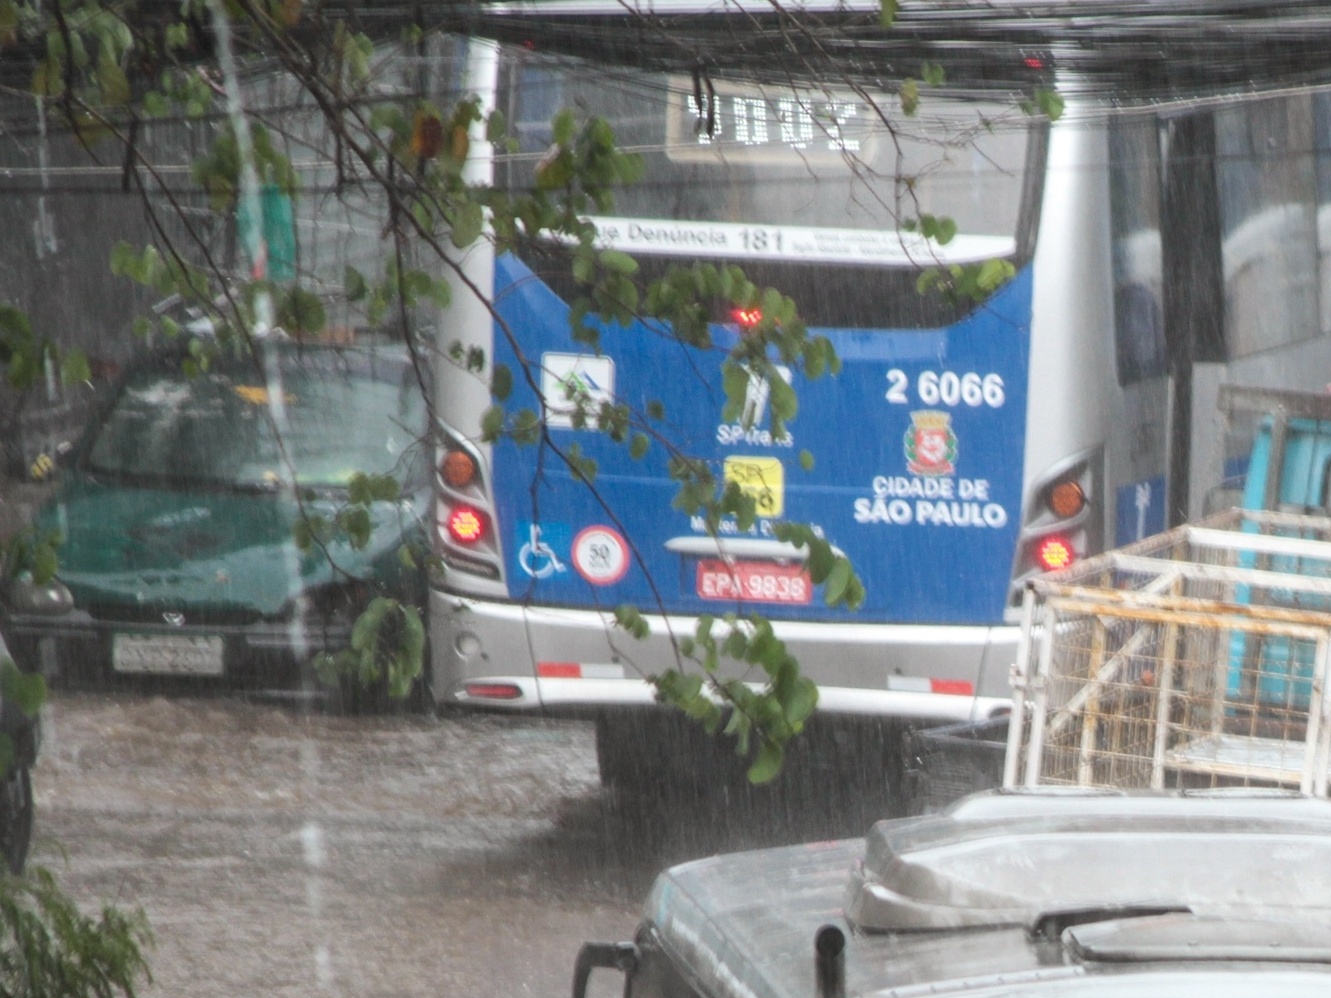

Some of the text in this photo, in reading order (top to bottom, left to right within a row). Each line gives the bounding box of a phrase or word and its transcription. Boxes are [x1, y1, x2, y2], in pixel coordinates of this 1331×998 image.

[628, 223, 727, 245] Denúncia
[739, 228, 783, 251] 181
[885, 368, 1006, 408] 2 6066
[872, 475, 990, 501] CIDADE DE
[853, 494, 1008, 529] SÃO PAULO
